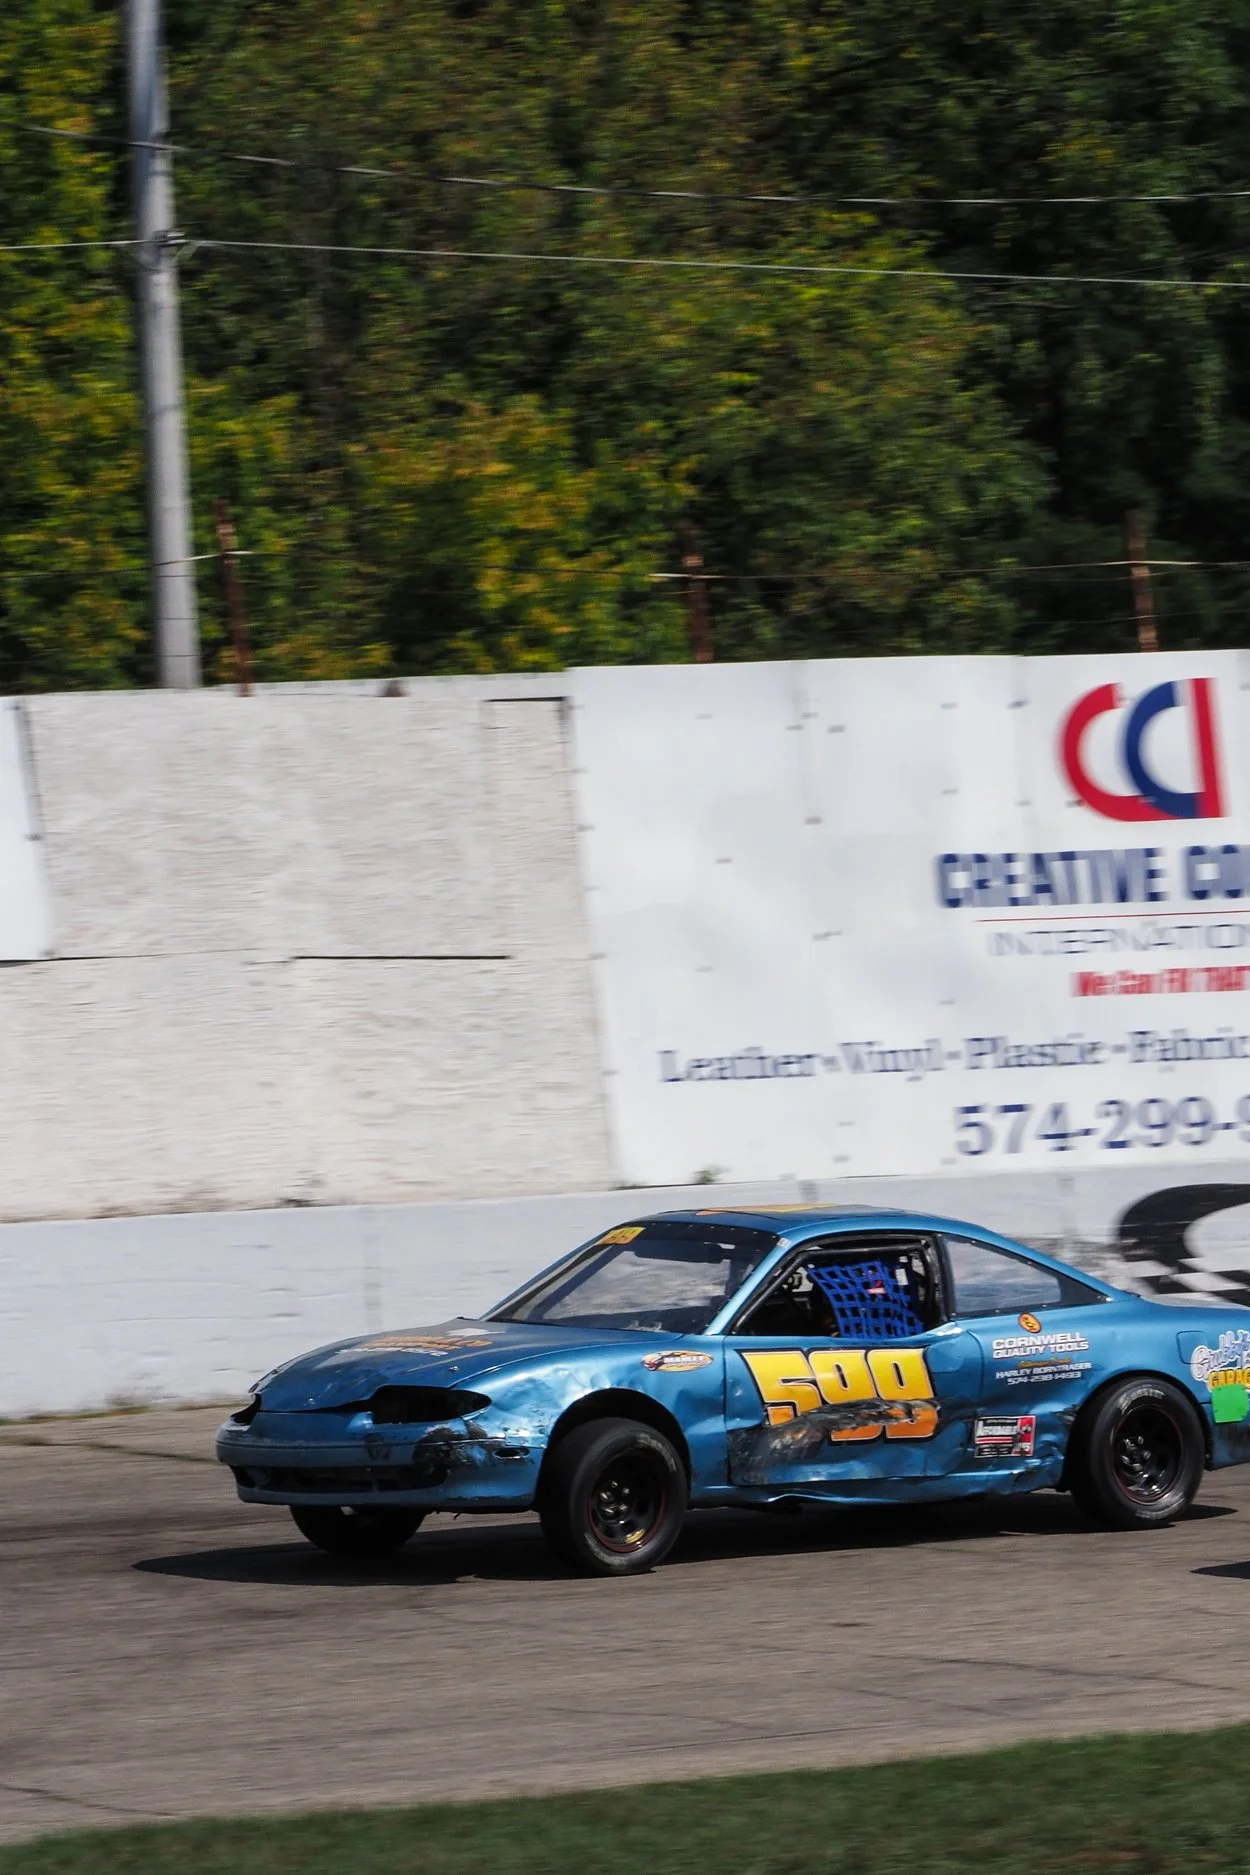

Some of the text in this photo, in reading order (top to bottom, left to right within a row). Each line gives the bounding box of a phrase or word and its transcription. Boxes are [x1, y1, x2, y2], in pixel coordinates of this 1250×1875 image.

[935, 847, 1167, 909] CREATIVE
[992, 1332, 1087, 1350] CORNWELL
[992, 1341, 1090, 1359] QUALITY TOOLS
